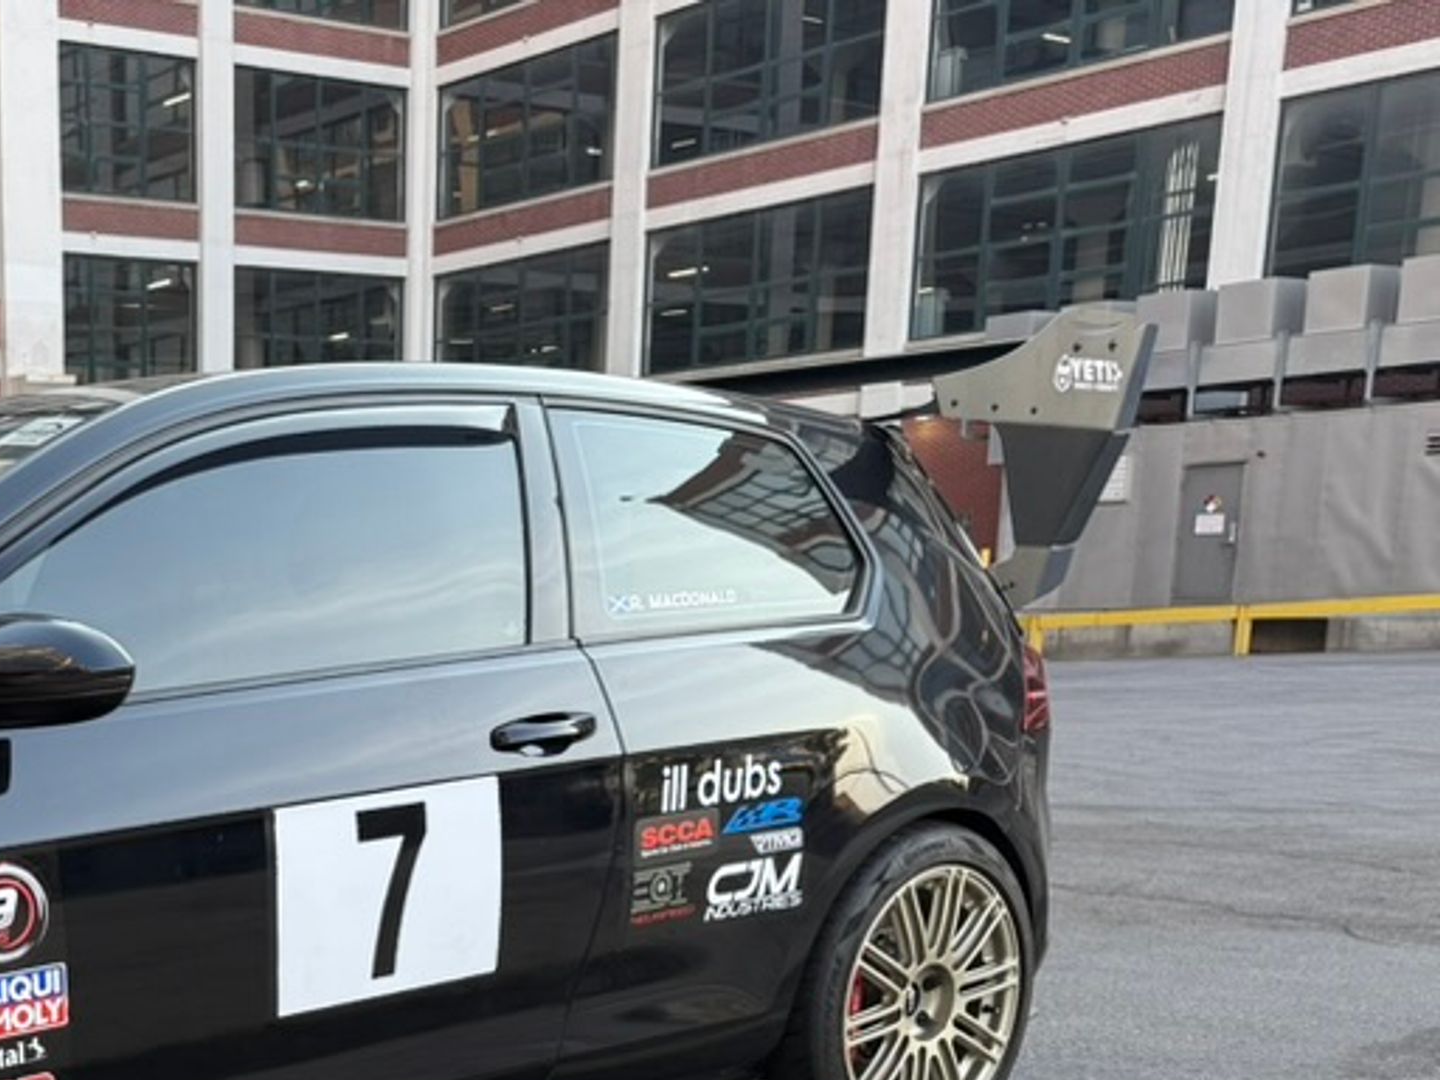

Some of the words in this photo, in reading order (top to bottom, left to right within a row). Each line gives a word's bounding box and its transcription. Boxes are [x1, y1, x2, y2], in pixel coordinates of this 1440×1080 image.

[661, 764, 688, 813] ill
[697, 754, 782, 806] dubs
[642, 818, 714, 850] SCCA
[356, 801, 427, 980] 7
